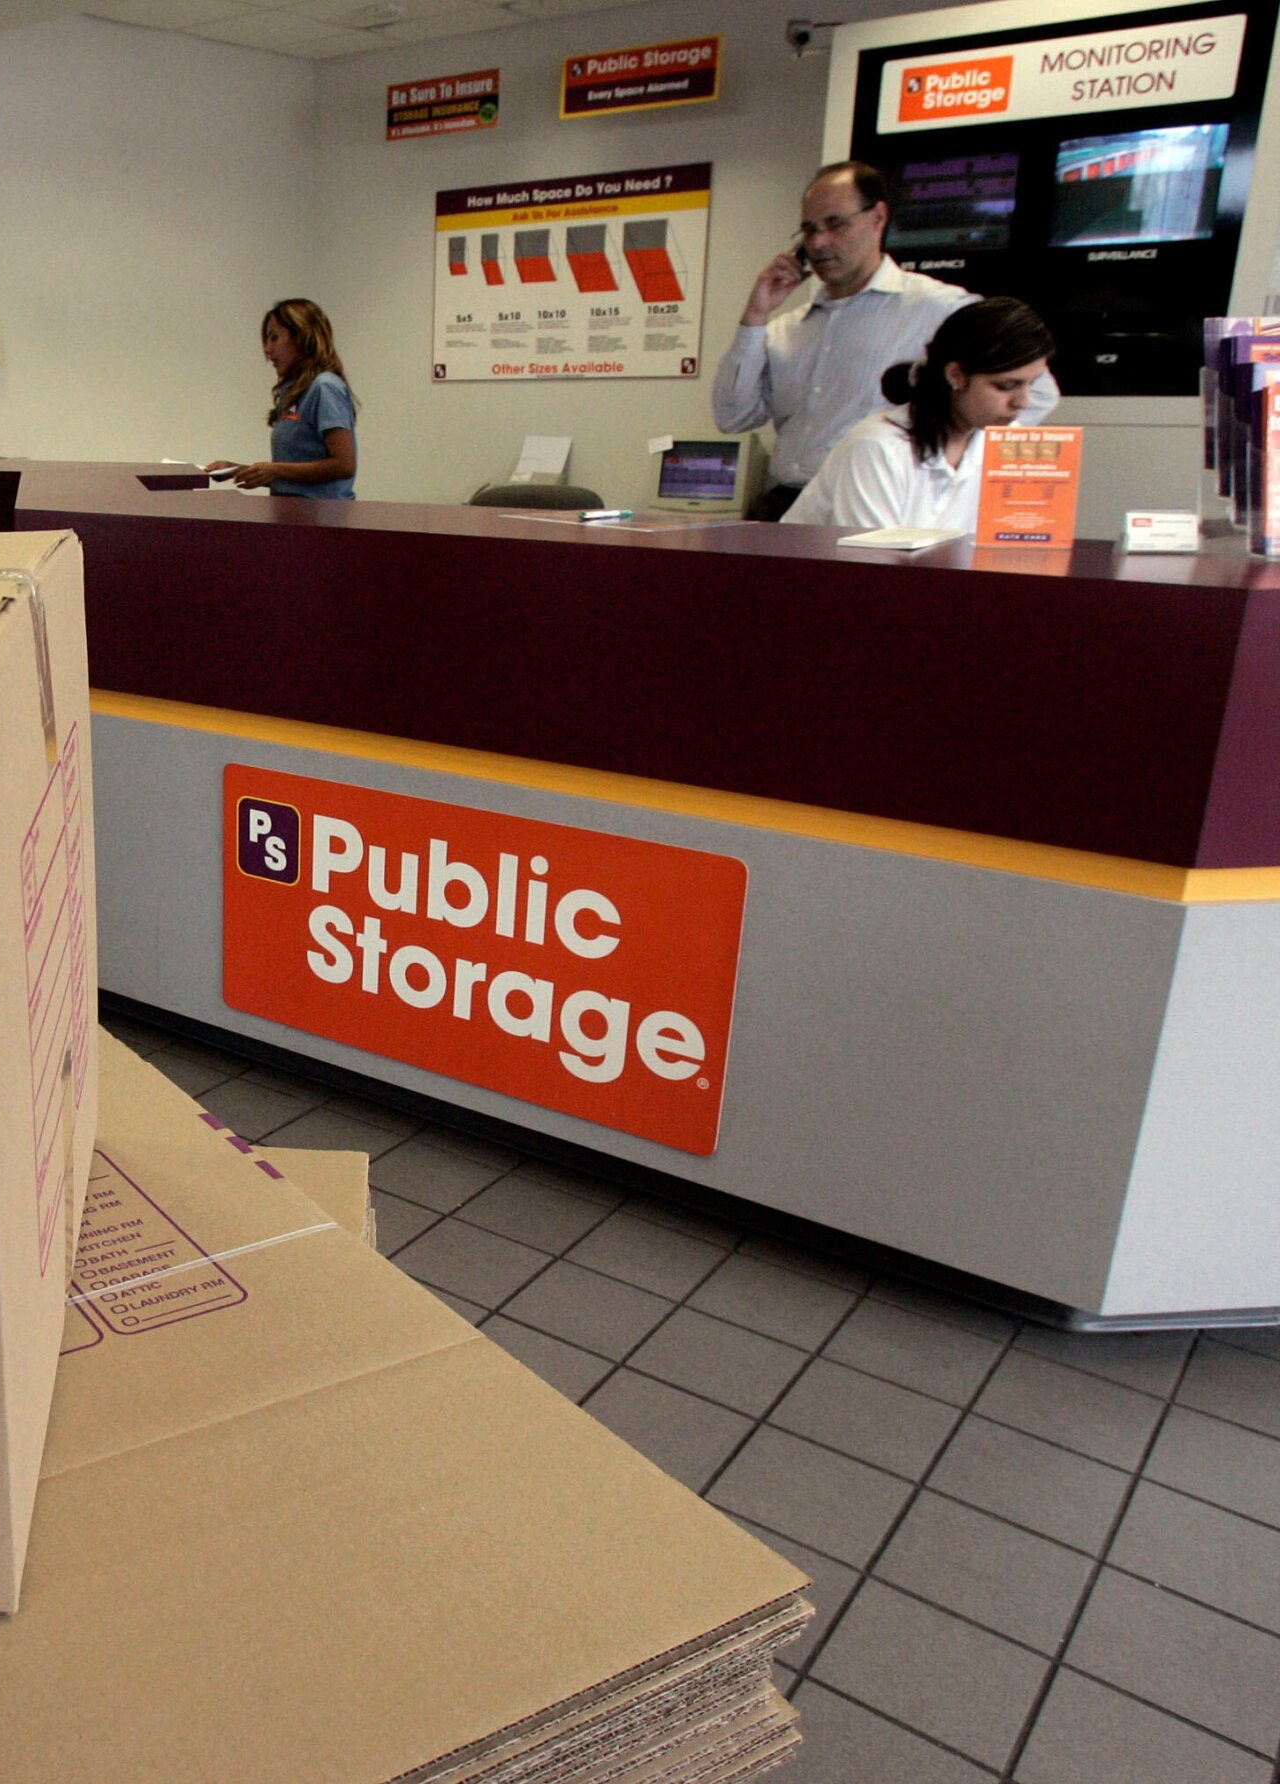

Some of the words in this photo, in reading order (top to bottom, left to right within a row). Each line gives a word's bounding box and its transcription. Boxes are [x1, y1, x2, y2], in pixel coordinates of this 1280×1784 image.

[586, 54, 639, 75] Public
[643, 45, 712, 67] Storage
[1040, 33, 1217, 74] MONITORING
[587, 89, 612, 101] Every
[613, 85, 645, 98] Space
[646, 78, 690, 93] Alarmed
[924, 69, 992, 91] Public
[1070, 71, 1177, 101] STATION
[391, 90, 407, 106] Be
[410, 87, 437, 103] Sure
[439, 81, 453, 98] To
[455, 78, 494, 96] Insure
[922, 85, 1006, 110] Storage
[467, 194, 493, 208] How
[496, 190, 529, 206] Much
[532, 187, 572, 204] Space
[575, 184, 594, 197] Do
[597, 181, 622, 195] You
[624, 178, 661, 193] Need
[664, 175, 673, 188] ?
[512, 211, 529, 222] Ask
[563, 204, 620, 218] Assistance
[1087, 248, 1159, 262] SURVEILLANCE
[456, 313, 473, 323] 5x5
[497, 311, 521, 321] 5x10
[537, 309, 566, 320] 10x10
[590, 307, 620, 317] 10x15
[647, 304, 679, 315] 10x20
[491, 362, 526, 375] Other
[528, 362, 558, 375] Sizes
[562, 361, 625, 374] Available
[248, 808, 287, 872] PS
[311, 813, 622, 960] Public
[306, 904, 706, 1084] Storage
[92, 1189, 116, 1200] RM
[99, 1200, 122, 1211] RM
[120, 1218, 145, 1230] RM
[78, 1231, 142, 1254] KITCHEN
[87, 1248, 129, 1265] BATH
[97, 1249, 177, 1275] BASEMENT
[120, 1281, 162, 1299] ATTIC
[127, 1285, 198, 1311] LAUNDRY
[200, 1278, 226, 1290] RM
